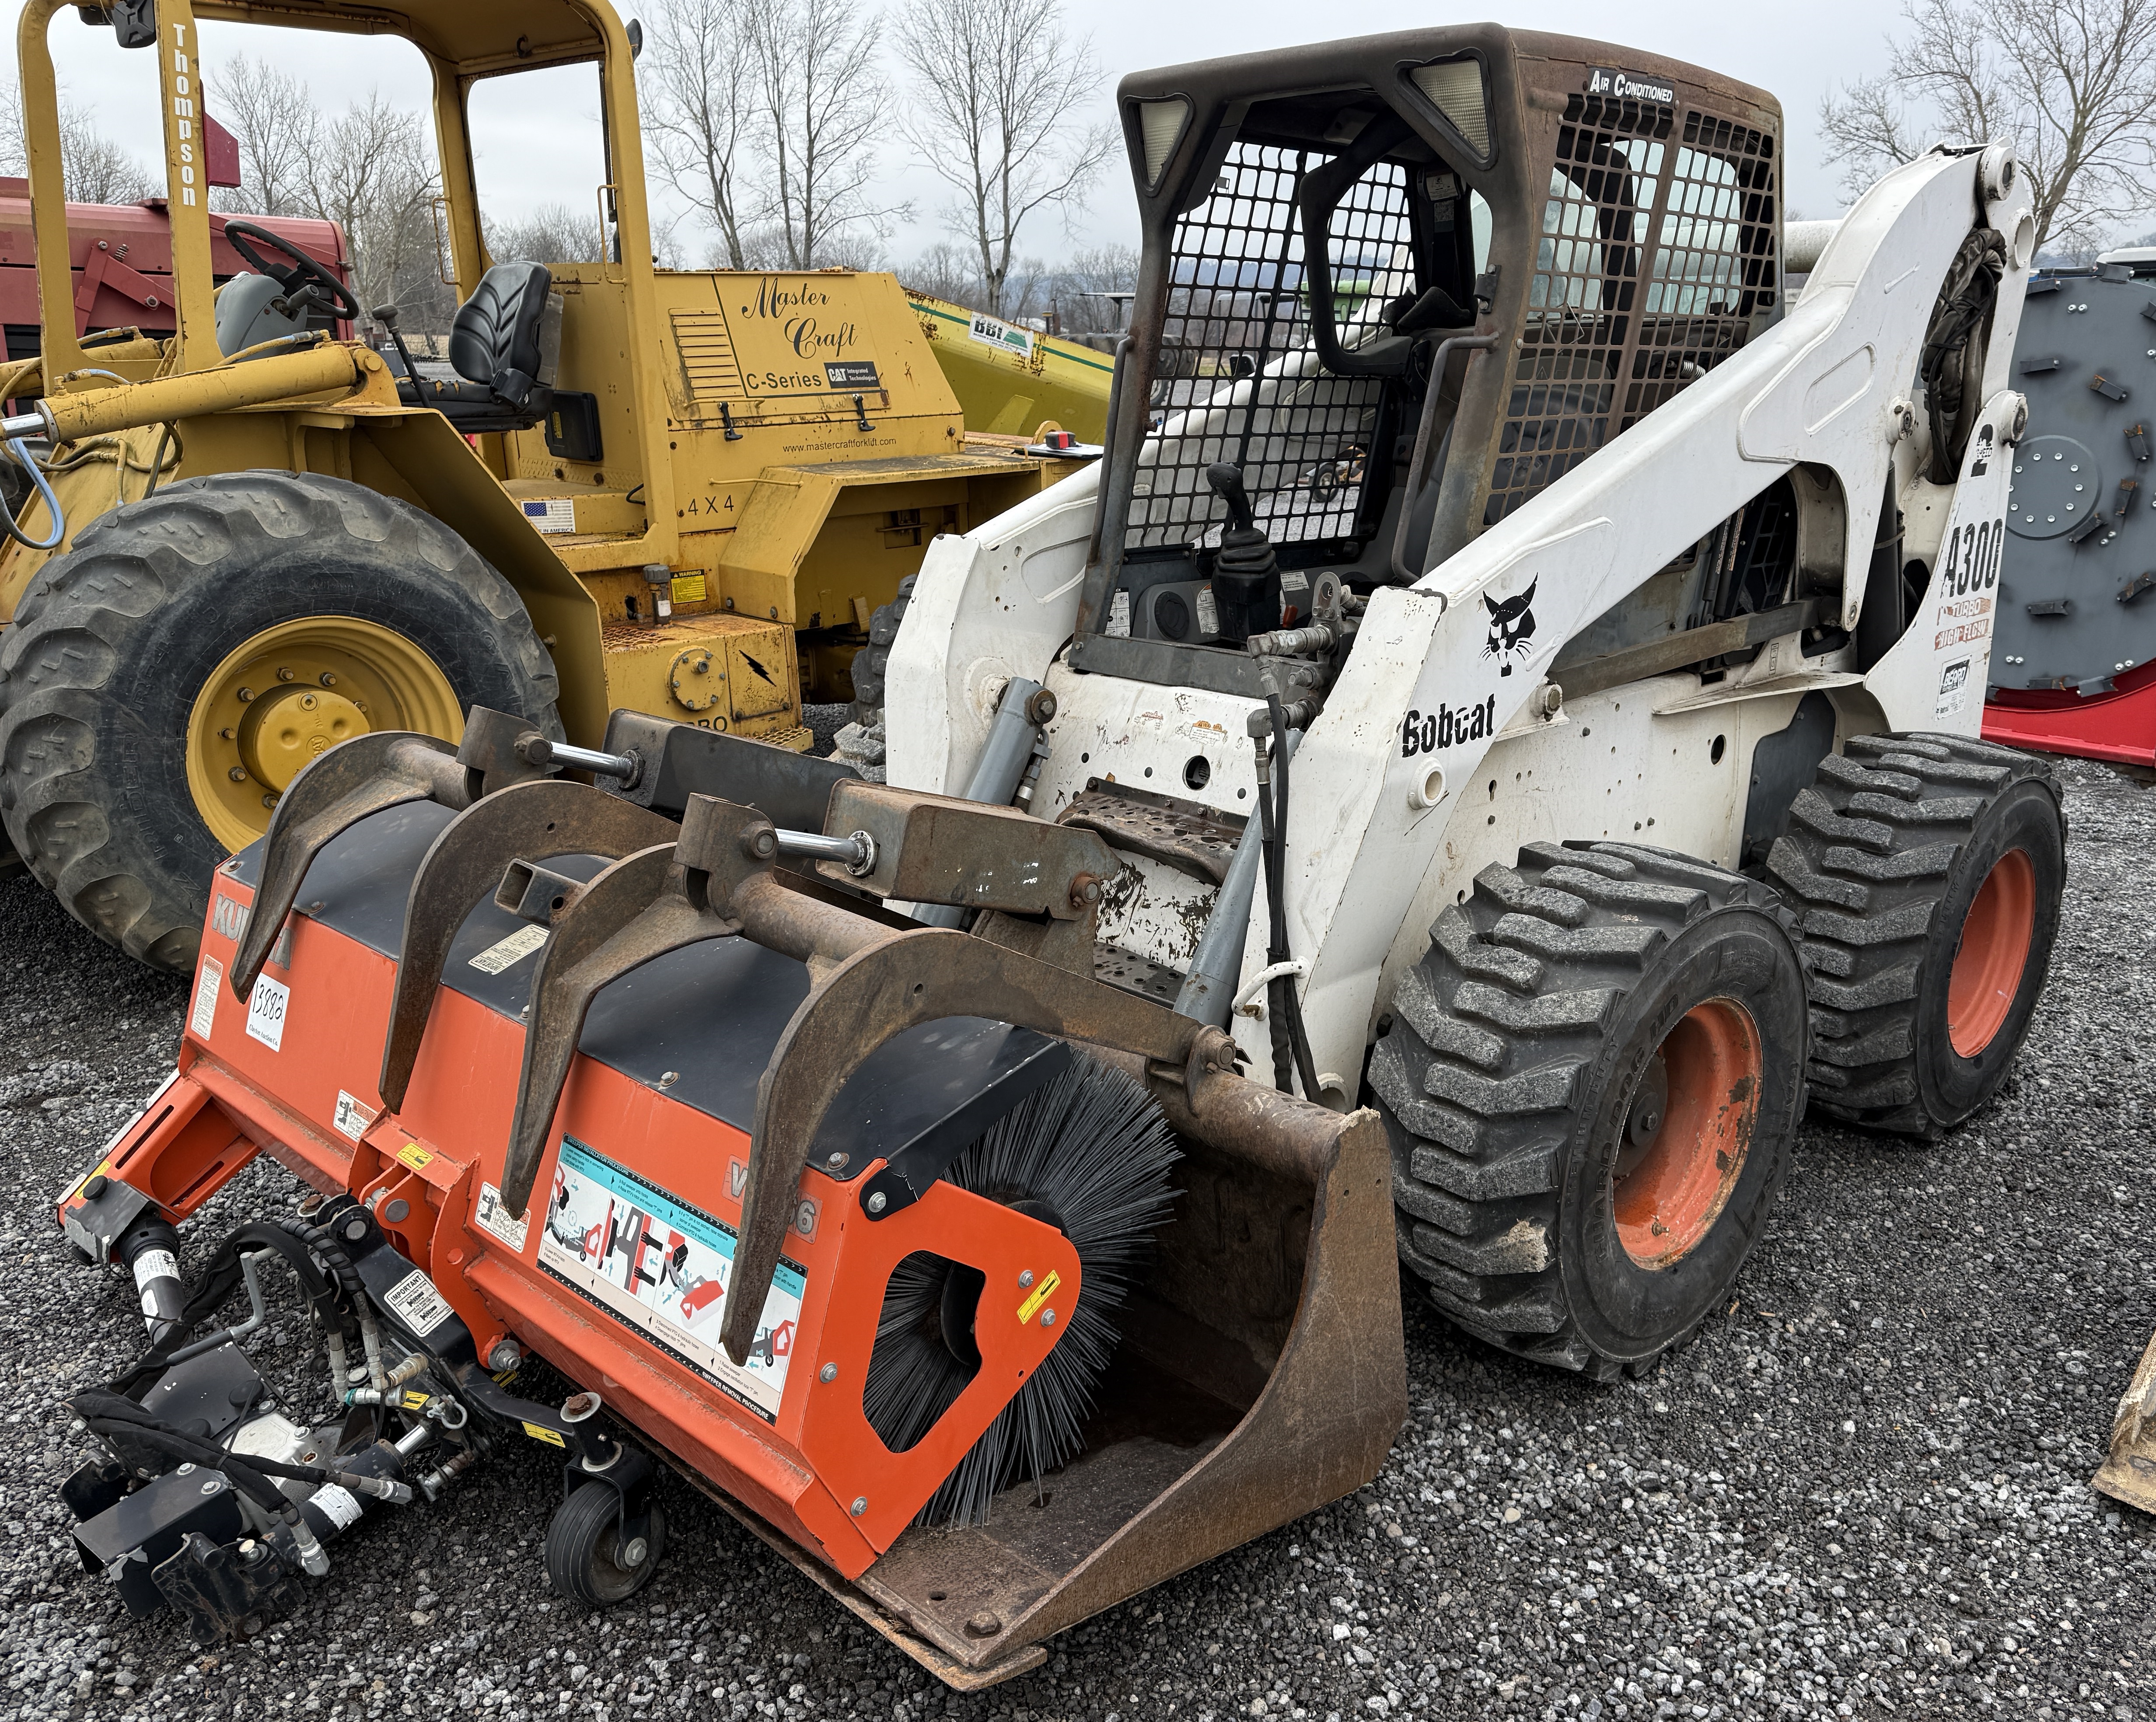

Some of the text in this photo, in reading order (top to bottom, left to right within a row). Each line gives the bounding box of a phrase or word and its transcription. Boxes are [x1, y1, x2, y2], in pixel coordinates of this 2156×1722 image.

[1590, 70, 1673, 102] AIR CONDITIONED
[173, 23, 196, 206] Thompson
[741, 277, 830, 318] Master
[784, 318, 858, 359] Craft
[975, 319, 1003, 339] BBI
[746, 372, 822, 390] C-Series
[828, 369, 847, 382] CAT
[783, 438, 897, 452] www.mastercraftforklift.com
[688, 498, 699, 515] 4
[724, 495, 734, 512] 4
[1940, 518, 2003, 599] A300
[1951, 599, 1981, 617] TURBO
[1938, 619, 1987, 649] HIGH FLOW
[1402, 693, 1496, 758] Bobcat
[475, 958, 502, 972] IMPORTANT
[253, 981, 284, 1024] 13882
[249, 1024, 261, 1036] Clayton
[260, 1031, 273, 1043] Auction
[567, 1136, 584, 1150] SWEEPER
[607, 1158, 629, 1175] PROCEDURE
[391, 1275, 422, 1302] IMPORTANT
[701, 1370, 769, 1421] SWEEPER REMOVAL PROCEDURE
